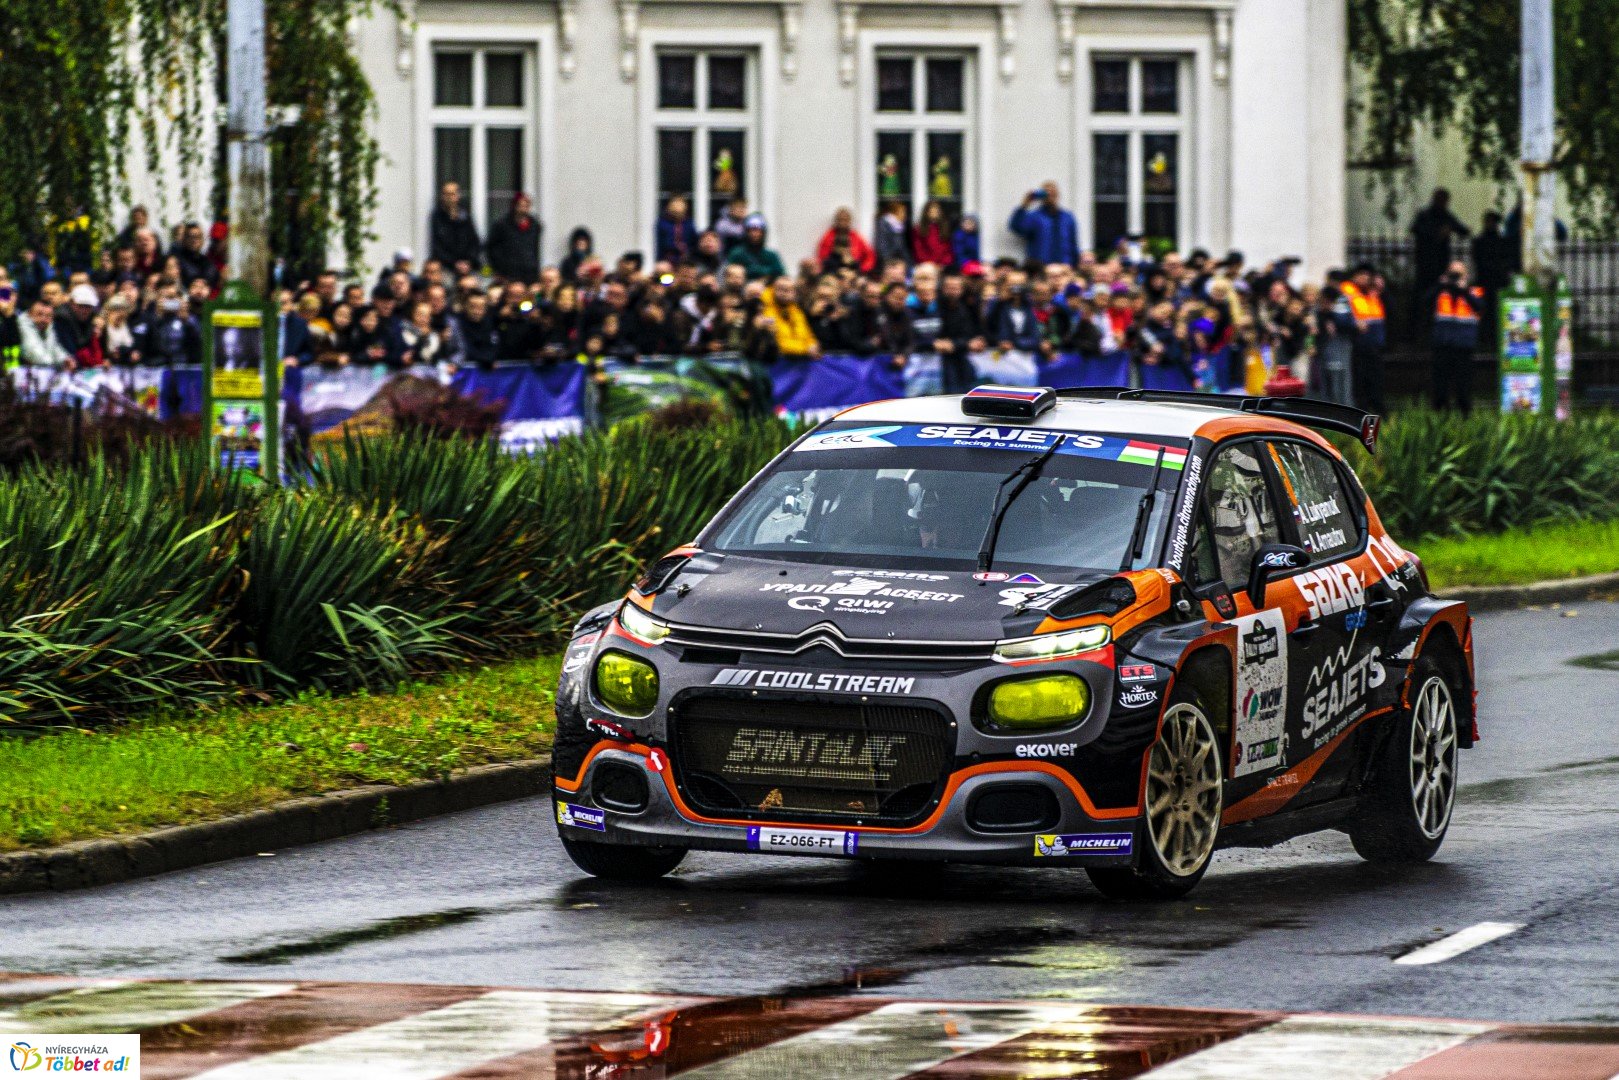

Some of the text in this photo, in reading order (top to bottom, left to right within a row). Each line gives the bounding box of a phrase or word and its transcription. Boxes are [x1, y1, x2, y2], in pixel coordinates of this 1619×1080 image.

[917, 426, 1105, 449] SEAJETS
[953, 439, 991, 448] Racing
[1168, 455, 1203, 571] boutique.citroenracing.com
[837, 598, 895, 609] QIWI
[833, 606, 886, 615] simplifying
[1121, 666, 1153, 677] ETS
[755, 671, 915, 694] COOLSTREAM
[1121, 690, 1158, 704] HORTEX
[1302, 646, 1386, 740] SEAJETS
[1015, 743, 1077, 757] ekover
[574, 810, 603, 823] MICHELIN
[751, 828, 757, 836] F
[770, 835, 835, 848] EZ-066-FT
[1070, 838, 1131, 848] MICHELIN
